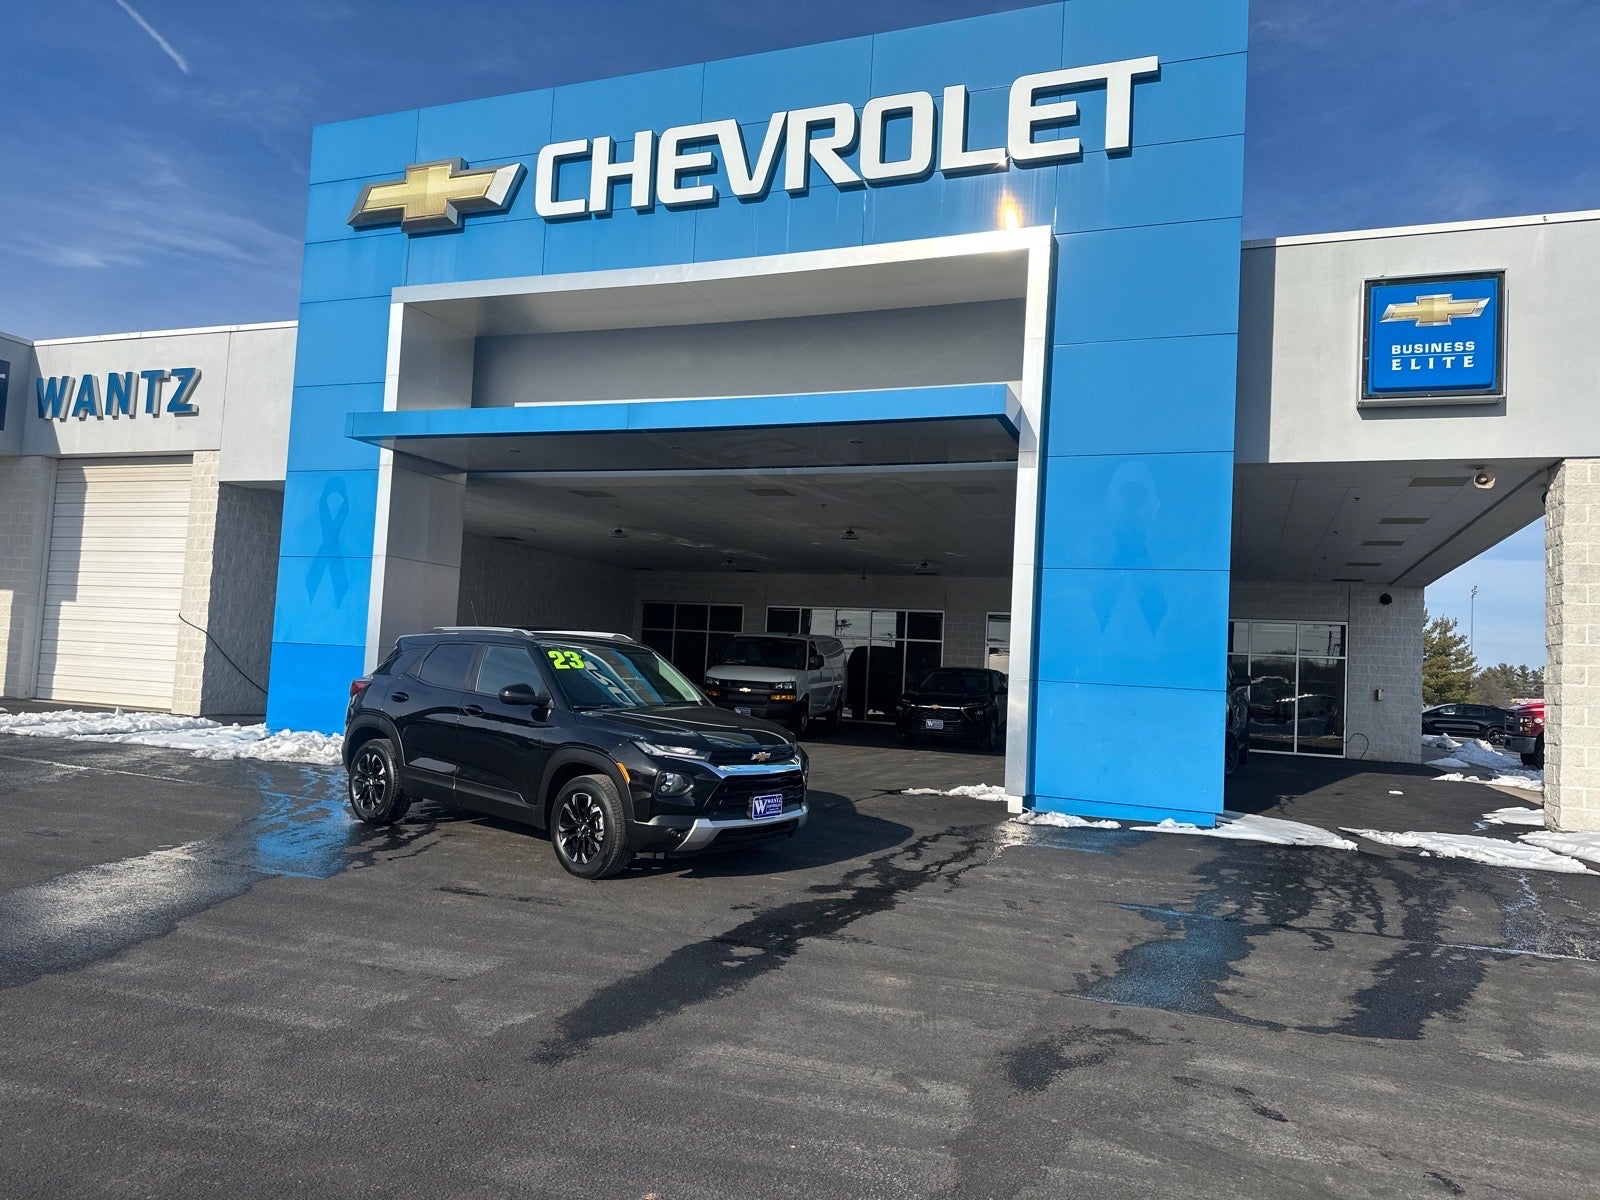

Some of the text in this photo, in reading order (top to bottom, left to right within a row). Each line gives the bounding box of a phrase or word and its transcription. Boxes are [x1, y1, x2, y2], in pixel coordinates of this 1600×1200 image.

[535, 55, 1160, 218] CHEVROLET
[1391, 341, 1476, 355] BUSINESS
[1391, 355, 1475, 371] ELITE
[36, 367, 202, 421] WANTZ
[548, 650, 585, 670] 23
[754, 799, 768, 815] W
